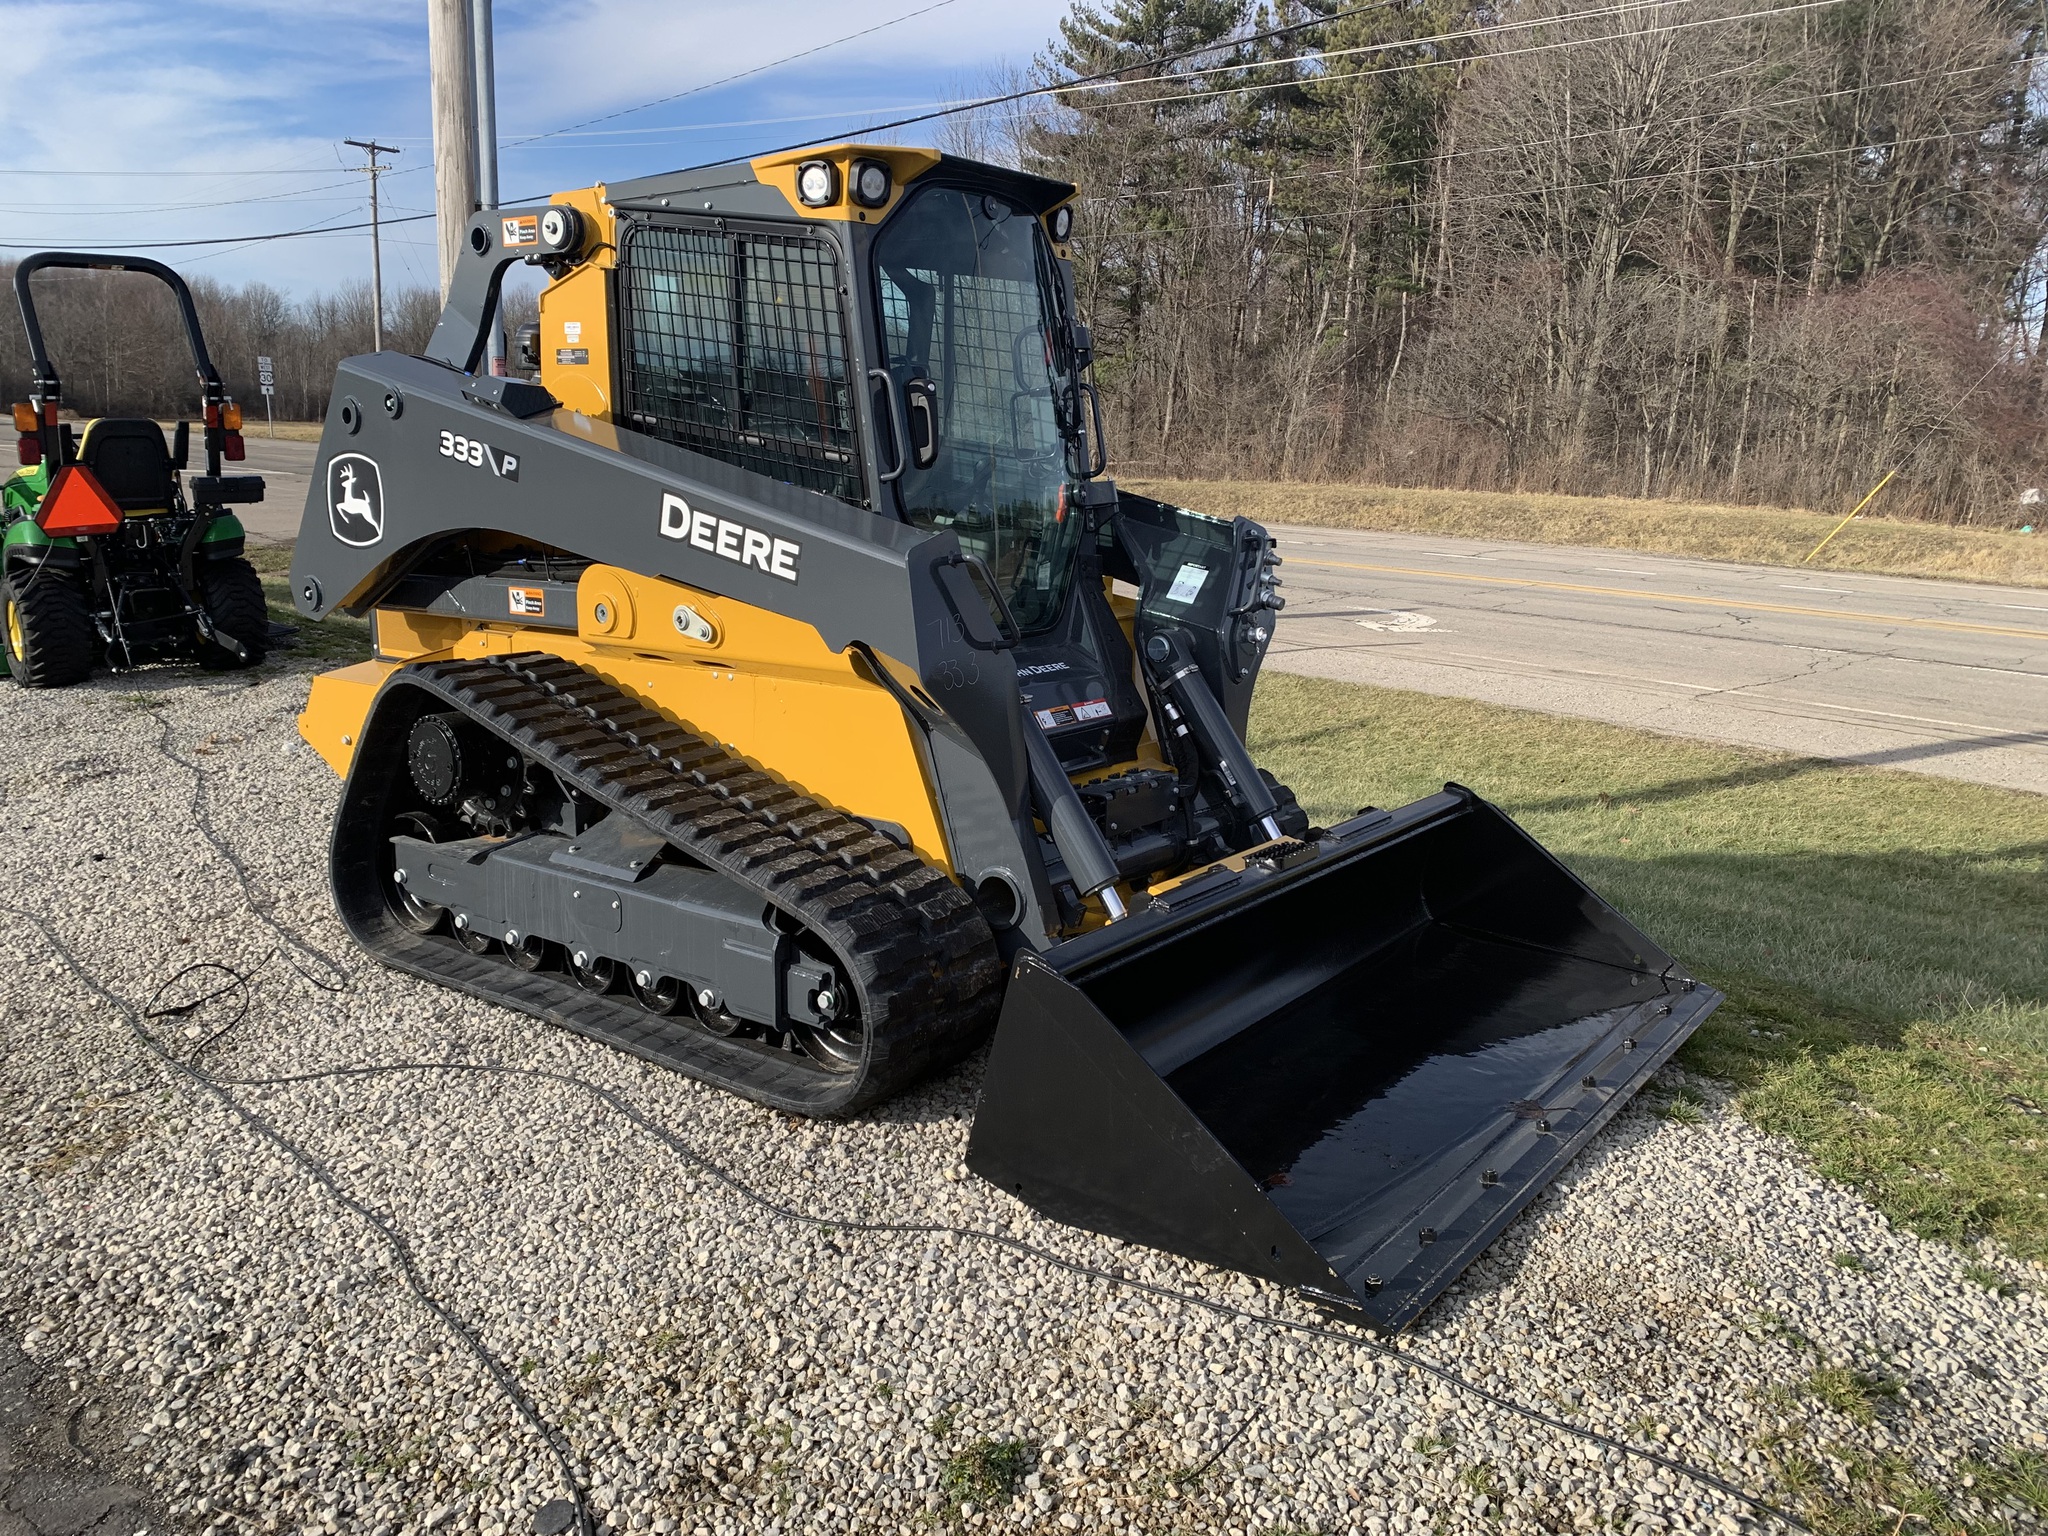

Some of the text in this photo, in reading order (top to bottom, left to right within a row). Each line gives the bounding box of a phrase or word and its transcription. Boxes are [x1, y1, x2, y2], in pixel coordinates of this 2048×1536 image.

[260, 374, 271, 382] 30
[660, 492, 800, 581] DEERE
[939, 652, 979, 690] 333
[1028, 662, 1070, 674] DEERE
